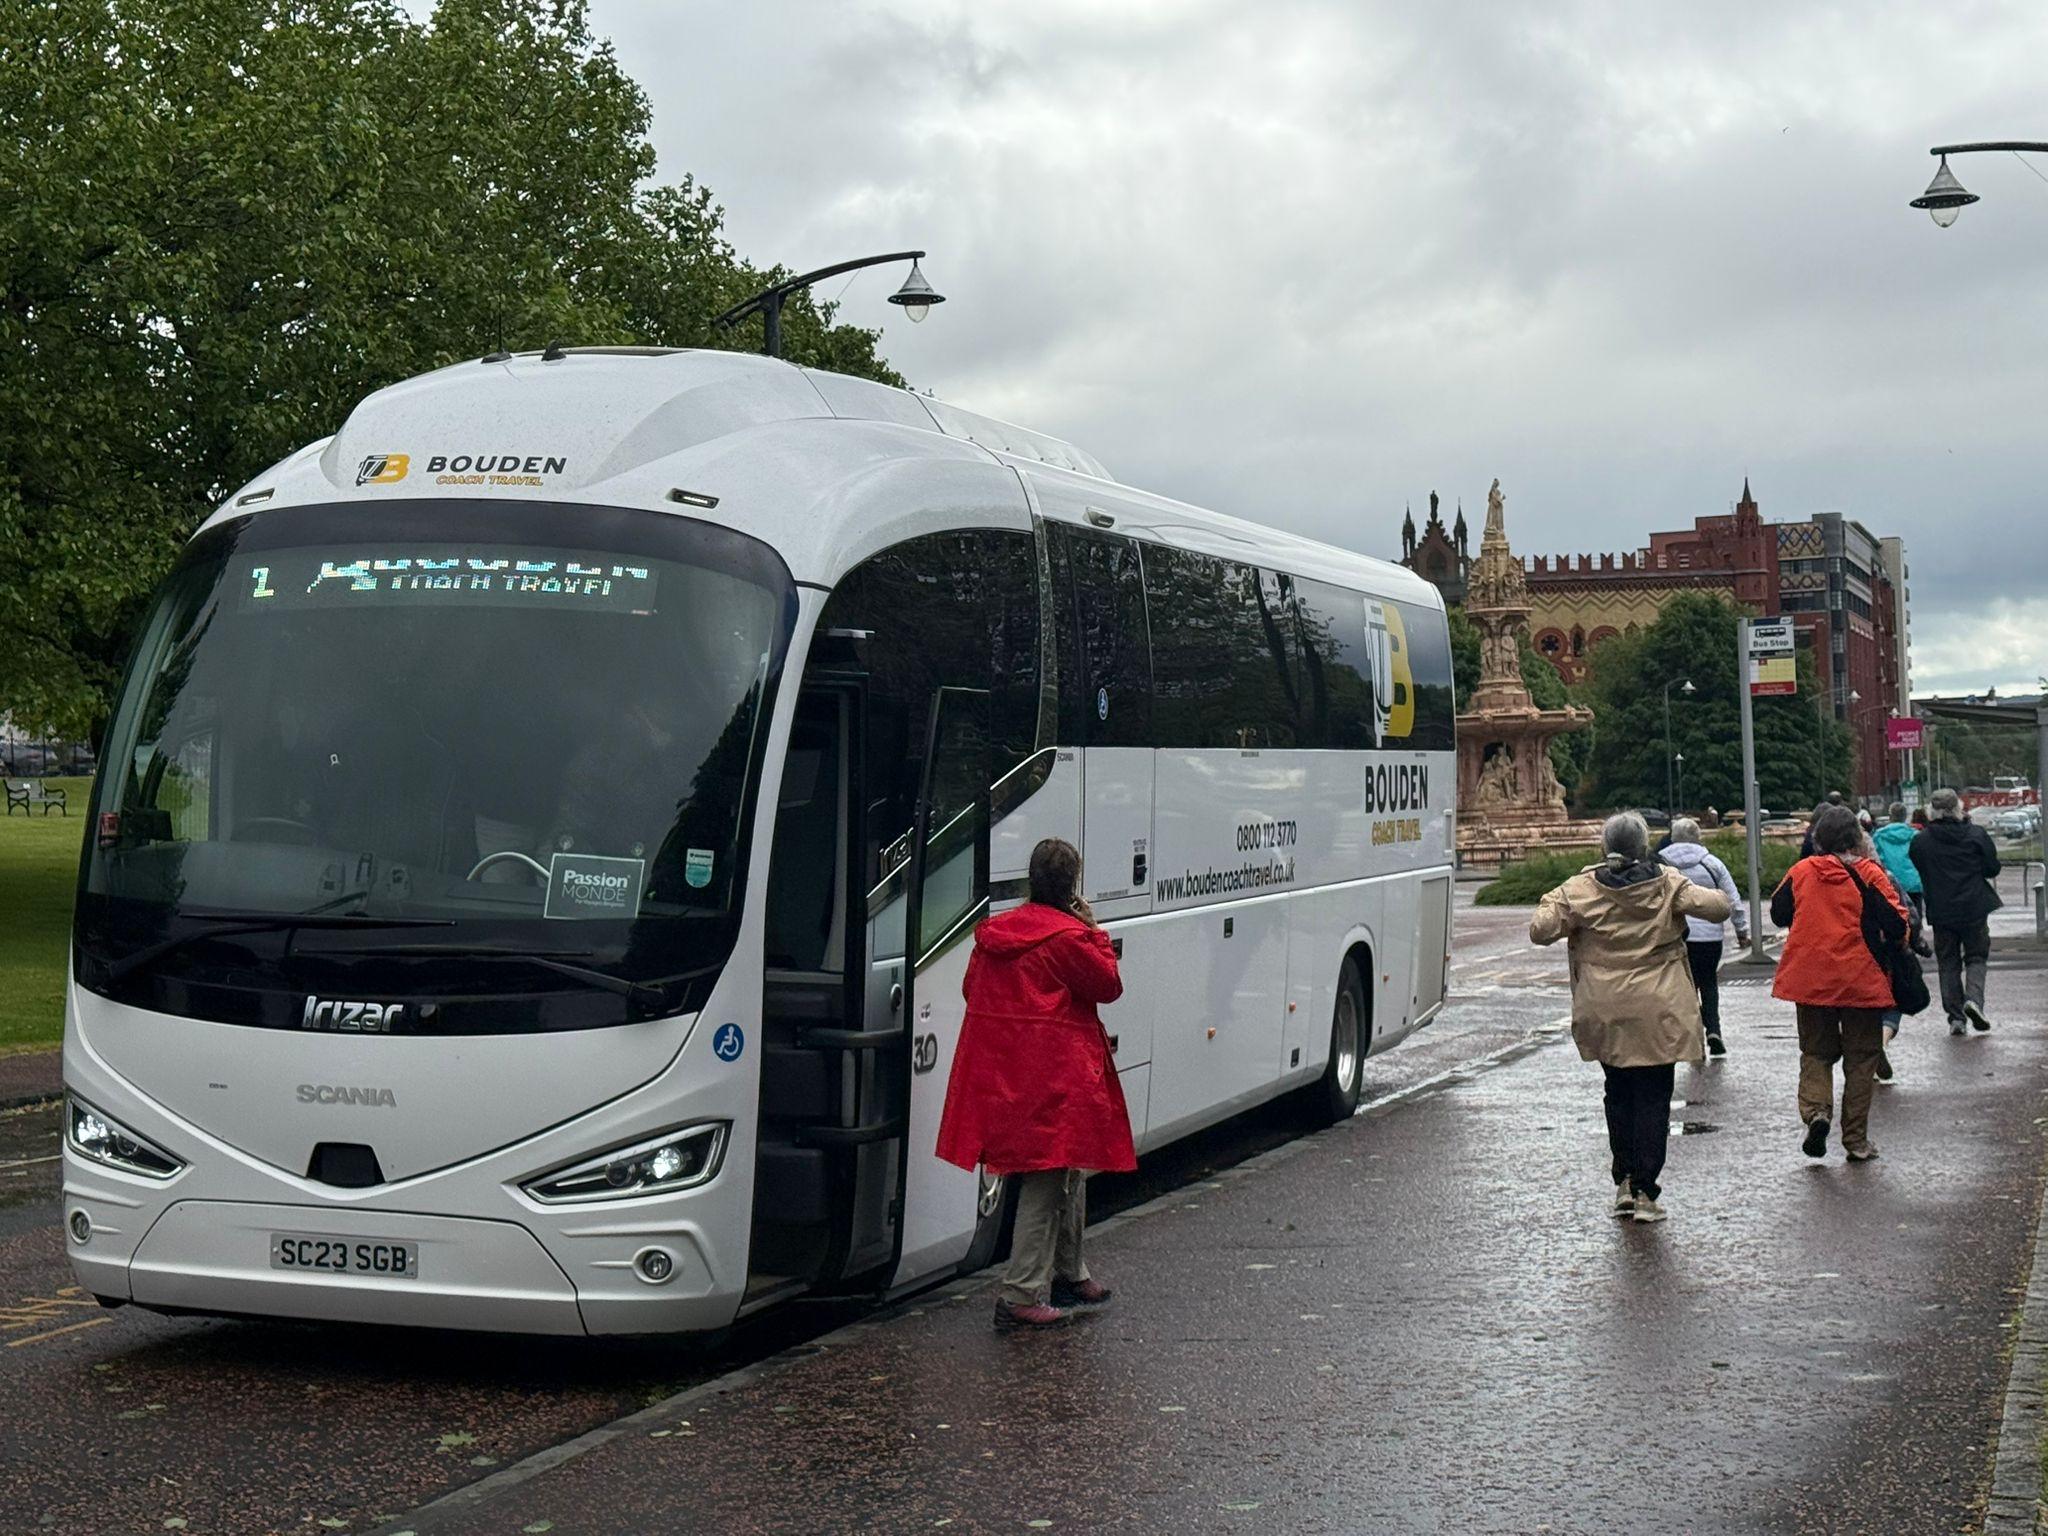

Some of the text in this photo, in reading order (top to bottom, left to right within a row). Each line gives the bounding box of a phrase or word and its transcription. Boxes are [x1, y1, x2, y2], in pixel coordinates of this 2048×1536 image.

[426, 456, 567, 474] BOUDEN
[436, 475, 543, 487] COACH TRAVEL
[1753, 638, 1789, 648] Bus Stop
[1365, 763, 1428, 814] BOUDEN
[1236, 820, 1297, 852] 0800 112 3770
[1371, 818, 1422, 847] COACH TRAVEL
[563, 869, 629, 889] Passion
[1156, 856, 1296, 903] www.boudencoachtravel.co.uk
[561, 884, 627, 902] MONDE
[302, 995, 404, 1032] Irizar
[296, 1084, 397, 1108] SCANIA
[280, 1238, 407, 1273] SC23 SGB
